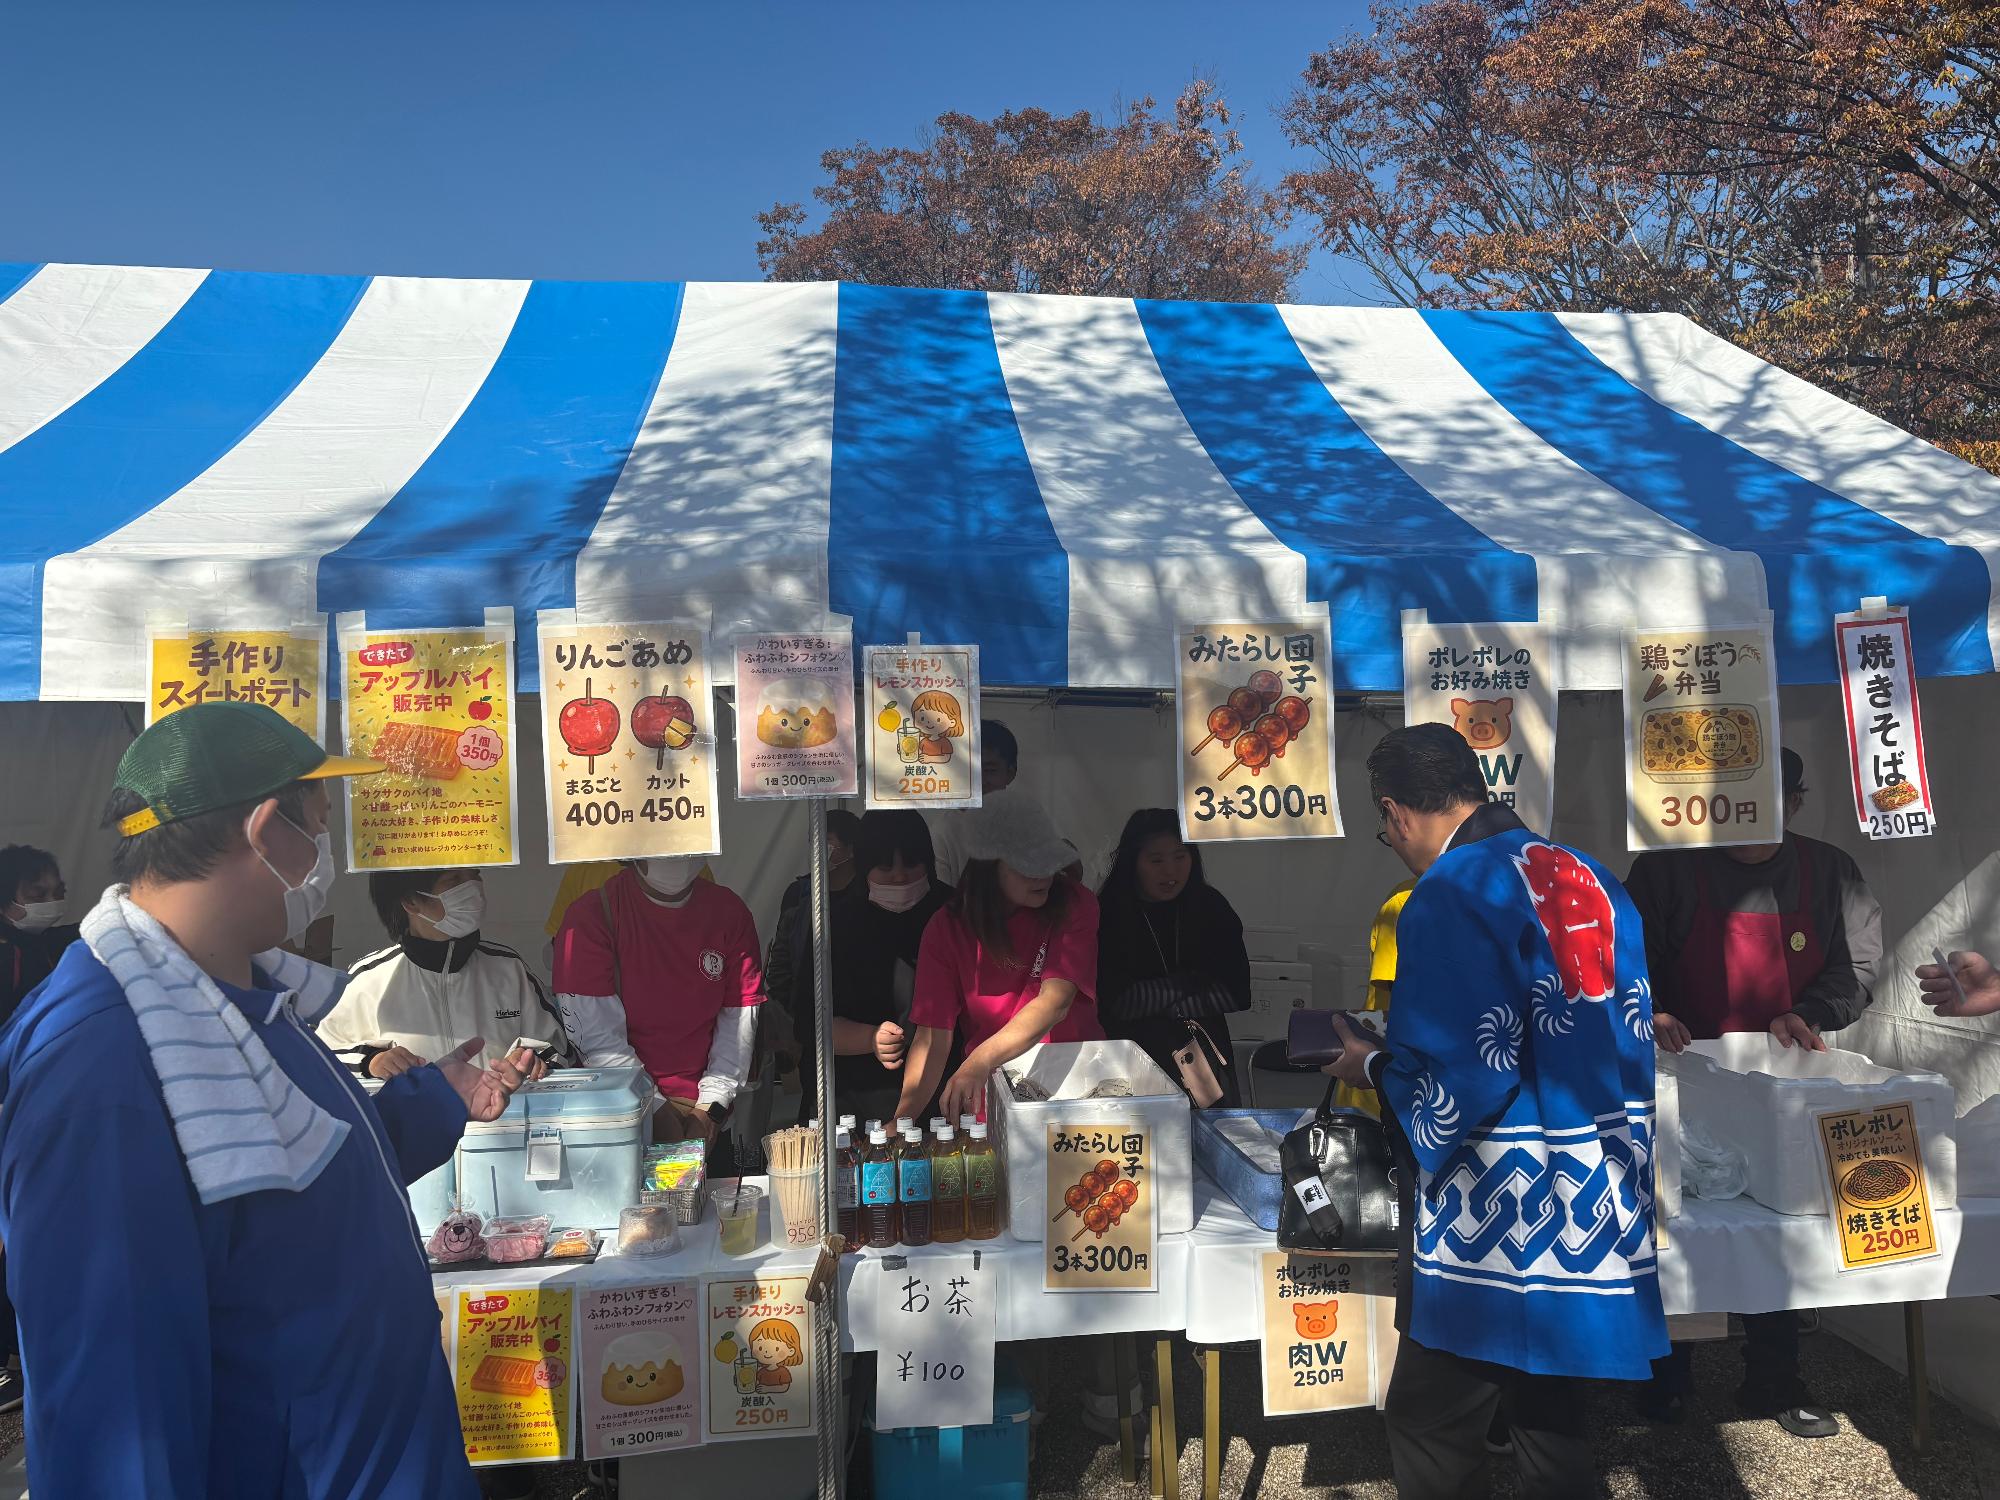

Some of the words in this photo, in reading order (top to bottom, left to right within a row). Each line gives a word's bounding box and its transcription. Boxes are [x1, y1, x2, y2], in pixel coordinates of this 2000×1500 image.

[189, 639, 284, 676] 手作り
[363, 647, 408, 662] できたて
[555, 639, 693, 671] りんごあめ
[1188, 633, 1315, 663] みたらし団
[1428, 645, 1531, 668] ポレポレの
[1640, 641, 1737, 672] 鶏ごぼう
[896, 658, 942, 673] 手作り
[359, 667, 494, 693] アップルパイ
[876, 675, 965, 689] レモンスカッシュ
[1287, 665, 1317, 693] 子
[1430, 669, 1531, 691] お好み焼き
[1673, 669, 1721, 696] 弁当
[159, 677, 312, 708] スイートポテト
[393, 693, 453, 712] 販売中
[1857, 633, 1907, 788] 焼きそば
[470, 733, 491, 747] 1個
[460, 745, 498, 763] 350円
[904, 765, 937, 776] 炭酸入
[1478, 753, 1523, 786] W
[565, 777, 622, 795] まるごと
[646, 773, 691, 791] カット
[899, 778, 950, 794] 250円
[360, 787, 443, 799] サクサクのパイ地
[1194, 784, 1328, 821] 3本300円
[566, 800, 634, 826] 400円
[640, 796, 705, 822] 450円
[1661, 793, 1757, 827] 300円
[361, 813, 498, 827] みんな大好き、手作りの美味しさ
[1869, 811, 1929, 837] 250円
[1830, 1113, 1904, 1140] ポレポレ
[1053, 1132, 1144, 1156] みたらし団
[1837, 1133, 1903, 1151] オリジナルソース
[1837, 1144, 1906, 1163] 冷めても美味しい
[1122, 1156, 1144, 1178] 子
[1846, 1202, 1922, 1235] 焼きそば
[787, 1225, 816, 1244] 950
[1861, 1228, 1920, 1254] 250円
[1052, 1245, 1148, 1272] 3本300円
[1276, 1262, 1350, 1282] ポレポレの
[599, 1286, 677, 1304] かわいすぎる！
[733, 1285, 781, 1302] 手作り
[900, 1275, 974, 1318] お茶
[1278, 1279, 1351, 1299] お好み焼き
[471, 1299, 504, 1311] できたて
[713, 1302, 806, 1320] レモンスカッシュ
[467, 1313, 562, 1334] アップルパイ
[490, 1333, 533, 1348] 販売中
[1288, 1340, 1348, 1369] 肉W
[896, 1351, 965, 1382] ¥100
[1294, 1368, 1344, 1387] 250円
[741, 1395, 775, 1408] 炭酸入
[735, 1409, 788, 1426] 250円
